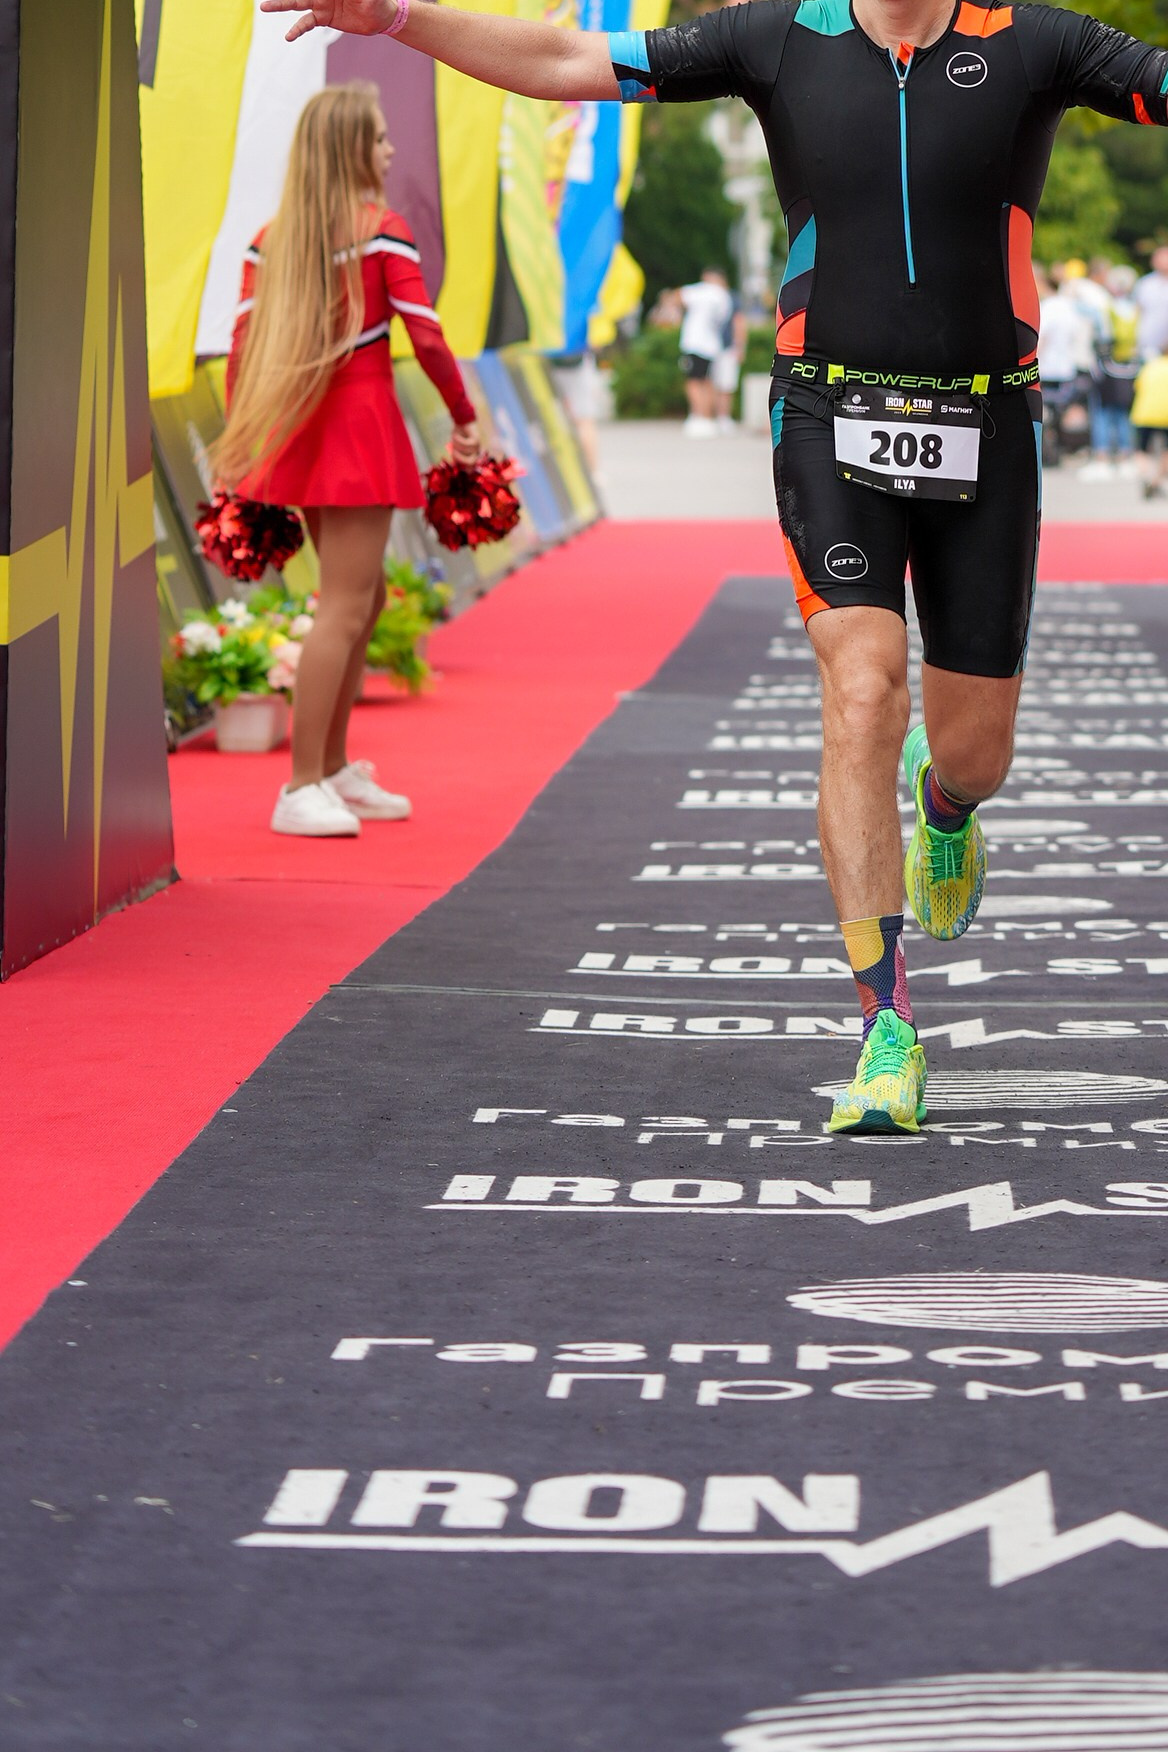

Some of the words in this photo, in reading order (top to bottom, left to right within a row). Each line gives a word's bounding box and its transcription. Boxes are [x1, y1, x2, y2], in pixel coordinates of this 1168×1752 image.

[845, 369, 972, 390] POWERUP
[885, 396, 905, 408] IRON
[912, 398, 933, 409] STAR
[869, 430, 943, 470] 208
[893, 478, 916, 491] ILYA
[443, 1173, 872, 1206] IRON
[262, 1469, 860, 1532] IRON
